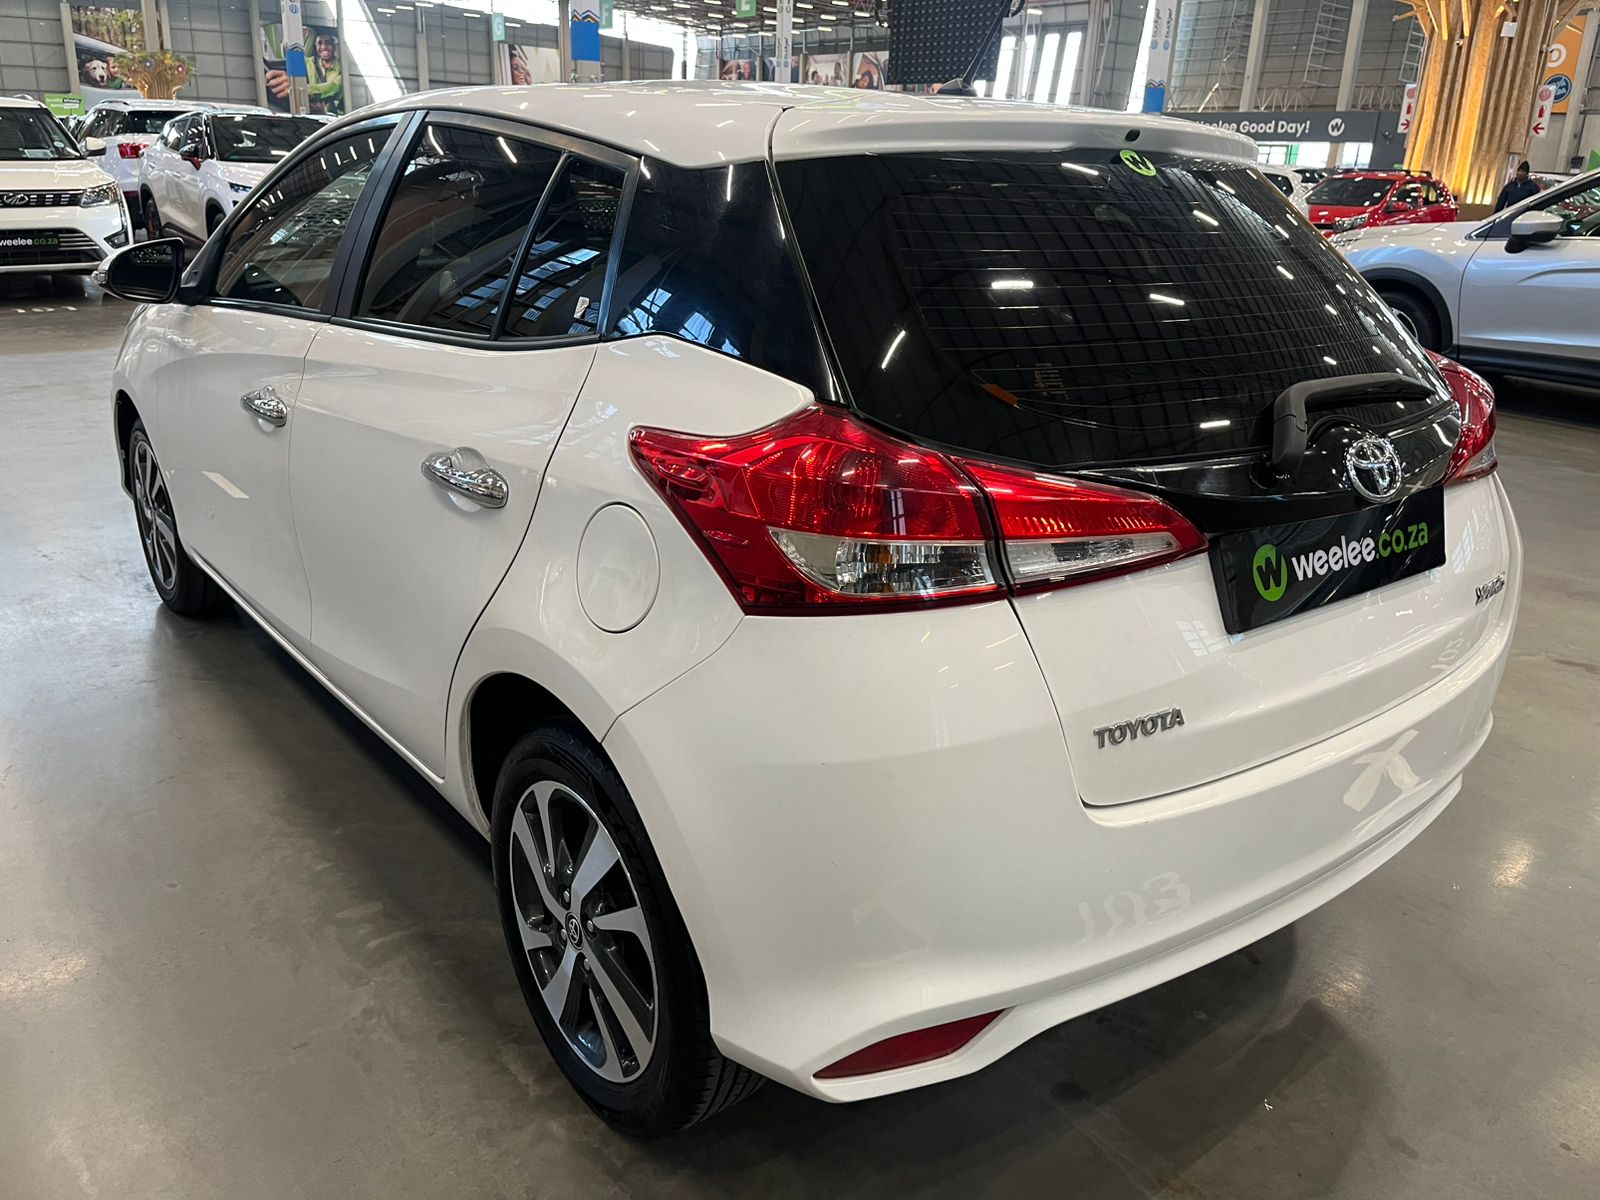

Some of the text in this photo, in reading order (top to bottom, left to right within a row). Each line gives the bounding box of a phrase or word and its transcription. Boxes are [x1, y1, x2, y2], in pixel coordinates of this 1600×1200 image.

[494, 17, 503, 36] G
[1239, 119, 1275, 133] Good
[1278, 120, 1311, 138] Day!
[1292, 520, 1429, 582] weelee.co.za
[1093, 706, 1185, 749] TOYOTA
